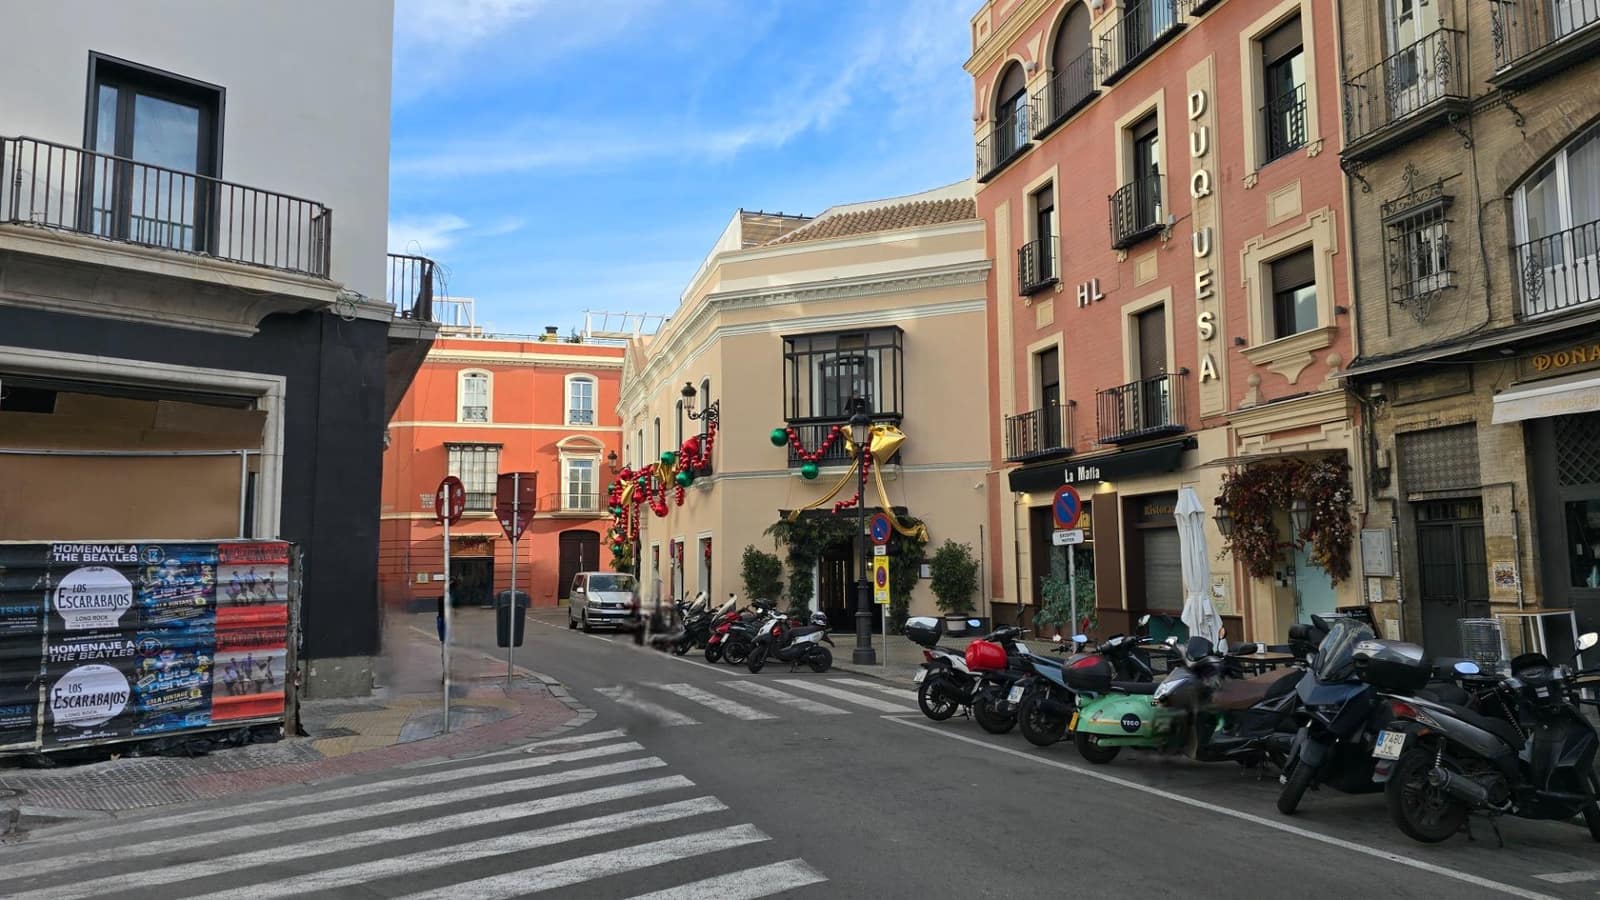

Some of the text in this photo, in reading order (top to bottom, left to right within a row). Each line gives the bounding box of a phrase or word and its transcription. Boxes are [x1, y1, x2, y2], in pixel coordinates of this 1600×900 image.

[1188, 89, 1219, 384] DUQUESA
[1077, 278, 1105, 308] HL
[1533, 344, 1600, 371] DONA
[1065, 466, 1100, 483] La Mafia
[53, 544, 138, 553] HOMENAJE A
[53, 553, 138, 562] THE BEATLES
[72, 584, 87, 593] LOS
[58, 587, 130, 611] ESCARABAJOS
[49, 640, 135, 654] HOMENAJE A
[50, 648, 135, 662] THE BEATLES
[68, 683, 82, 693] LOS
[54, 688, 127, 711] ESCARABAJOS
